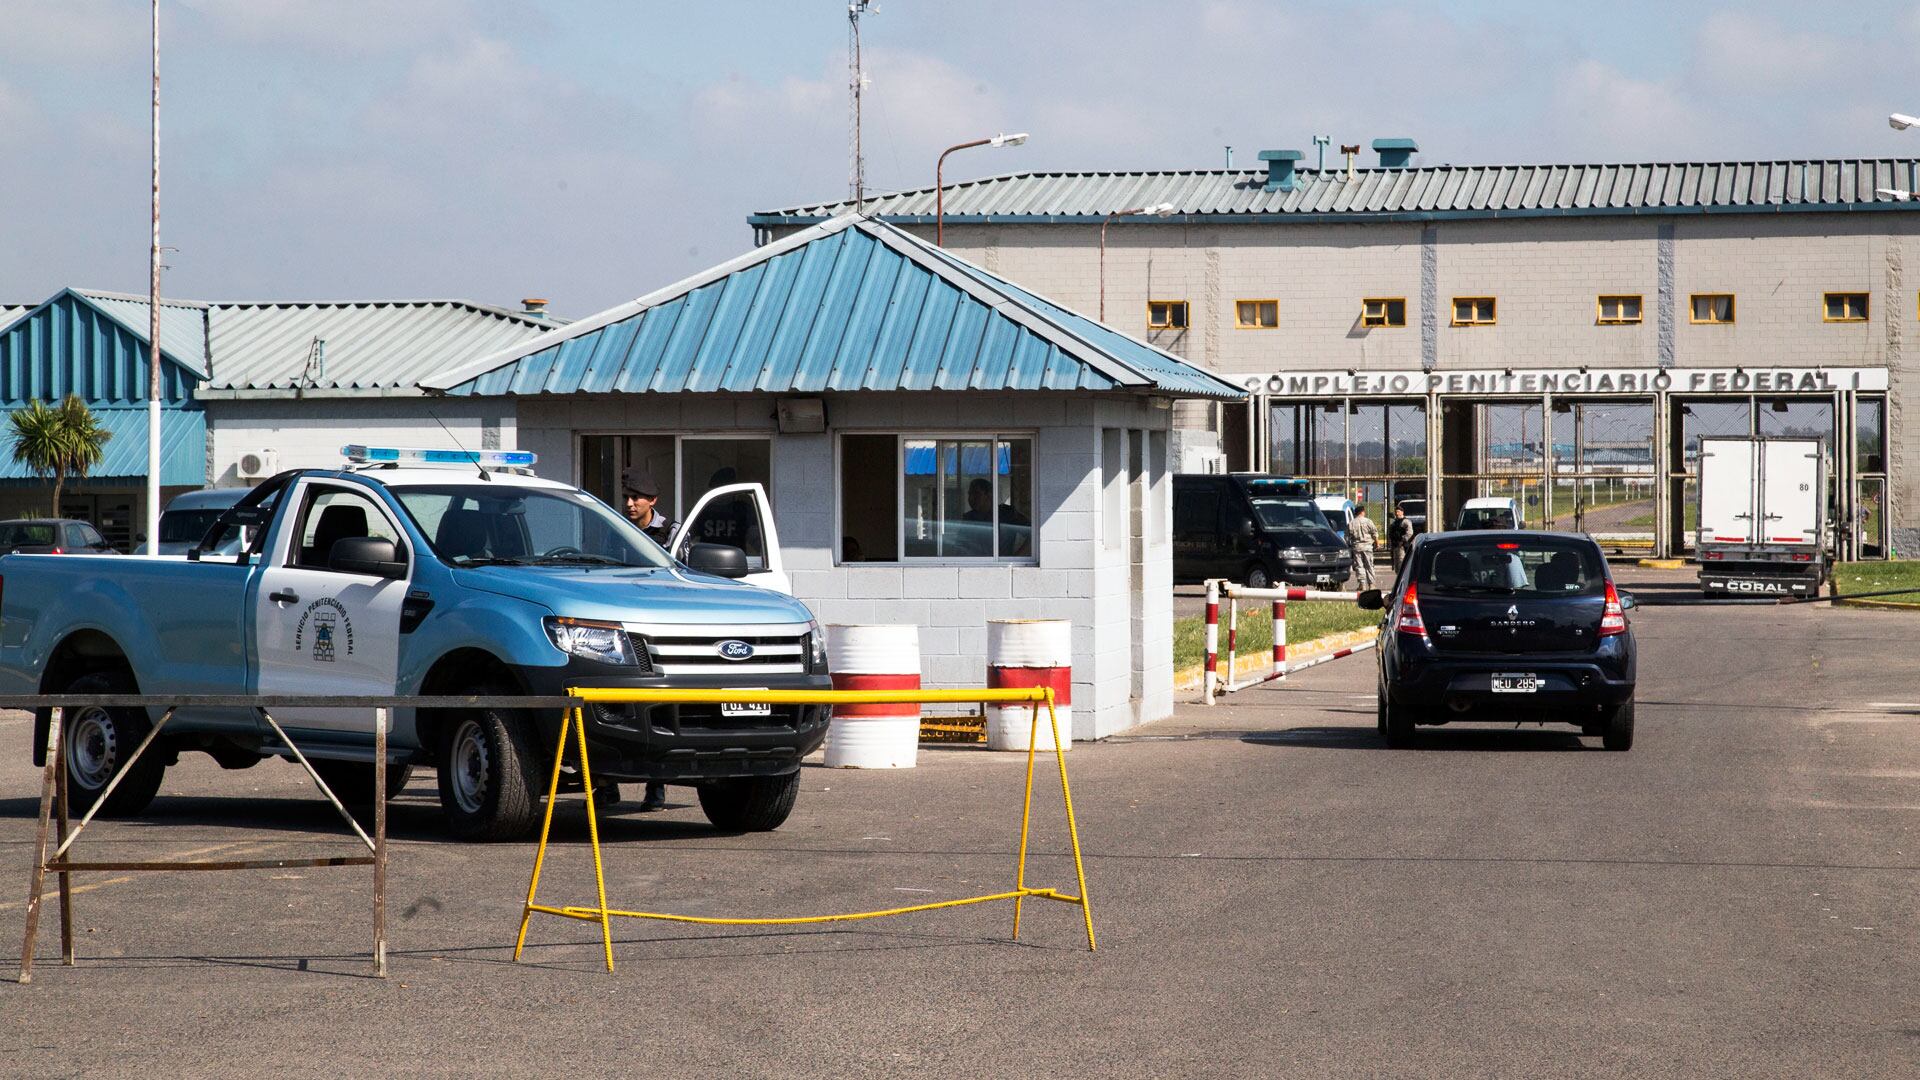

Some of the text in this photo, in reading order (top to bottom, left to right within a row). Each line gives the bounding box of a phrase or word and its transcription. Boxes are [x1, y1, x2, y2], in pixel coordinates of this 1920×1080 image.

[1244, 371, 1861, 394] COMPLEJO PENITENCIARIO FEDERAL I
[1799, 483, 1809, 492] 80
[1726, 582, 1788, 593] CORAL
[295, 597, 354, 656] SERVICIO PENITENCIARIO FEDERAL
[727, 643, 748, 655] Ford
[1516, 678, 1535, 689] 285
